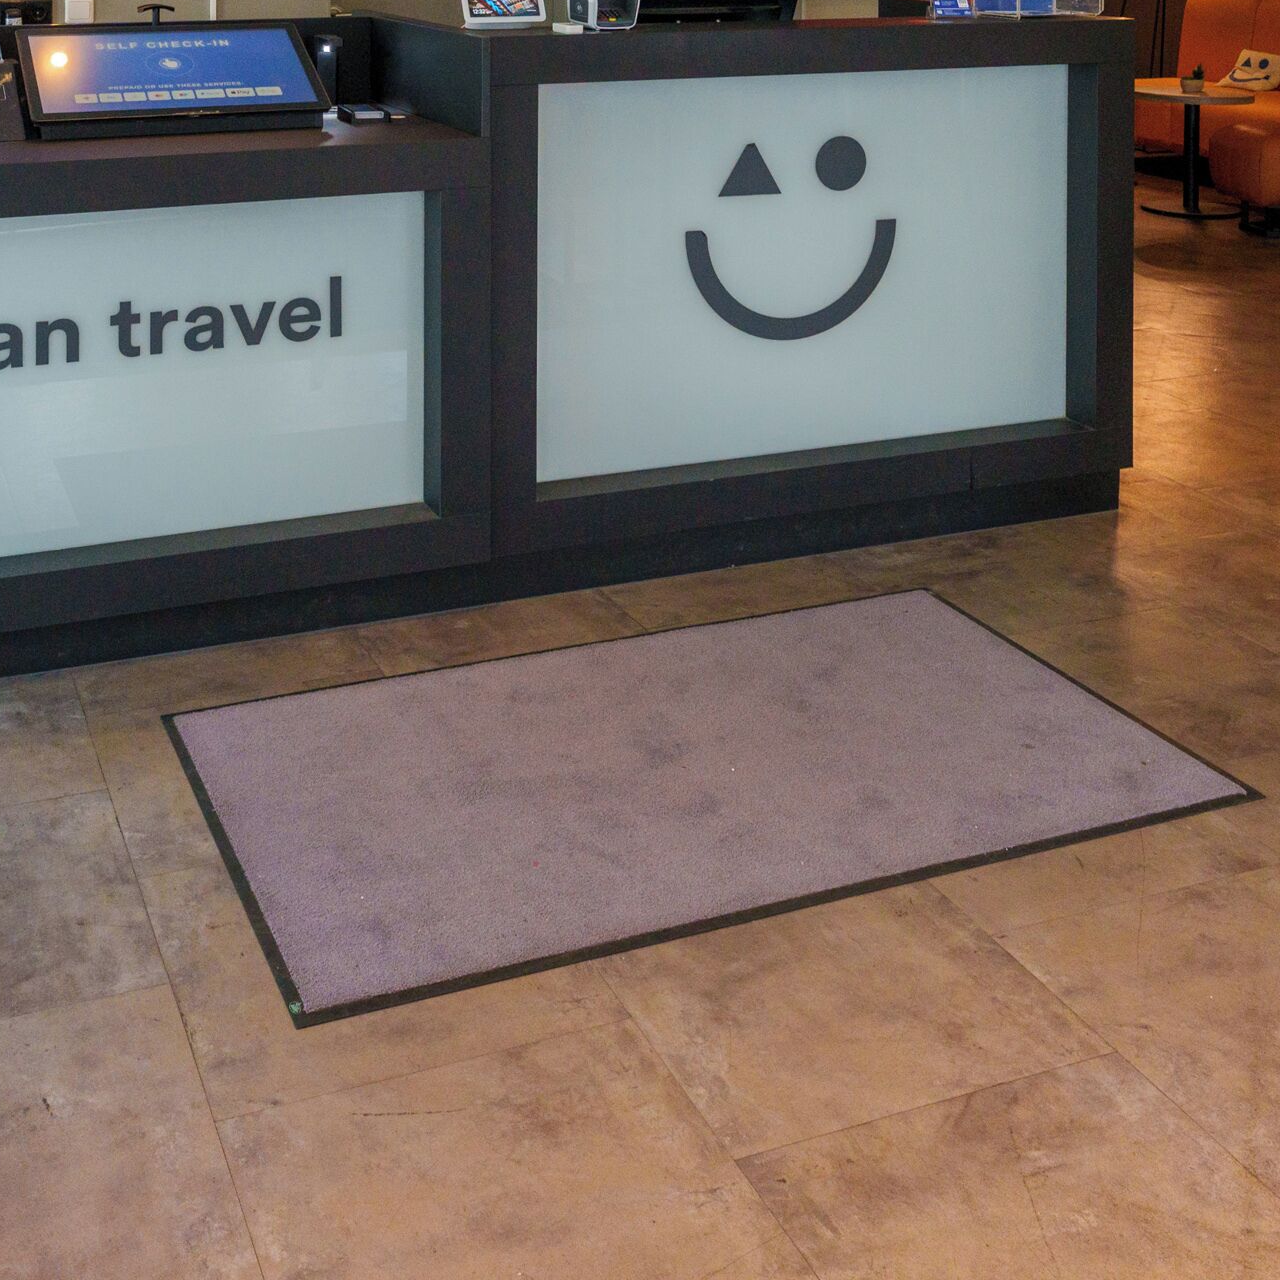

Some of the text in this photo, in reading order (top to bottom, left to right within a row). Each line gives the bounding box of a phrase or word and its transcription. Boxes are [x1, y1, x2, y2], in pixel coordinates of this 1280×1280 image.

[95, 39, 230, 50] SELF CHECK-IN
[110, 275, 345, 359] travel
